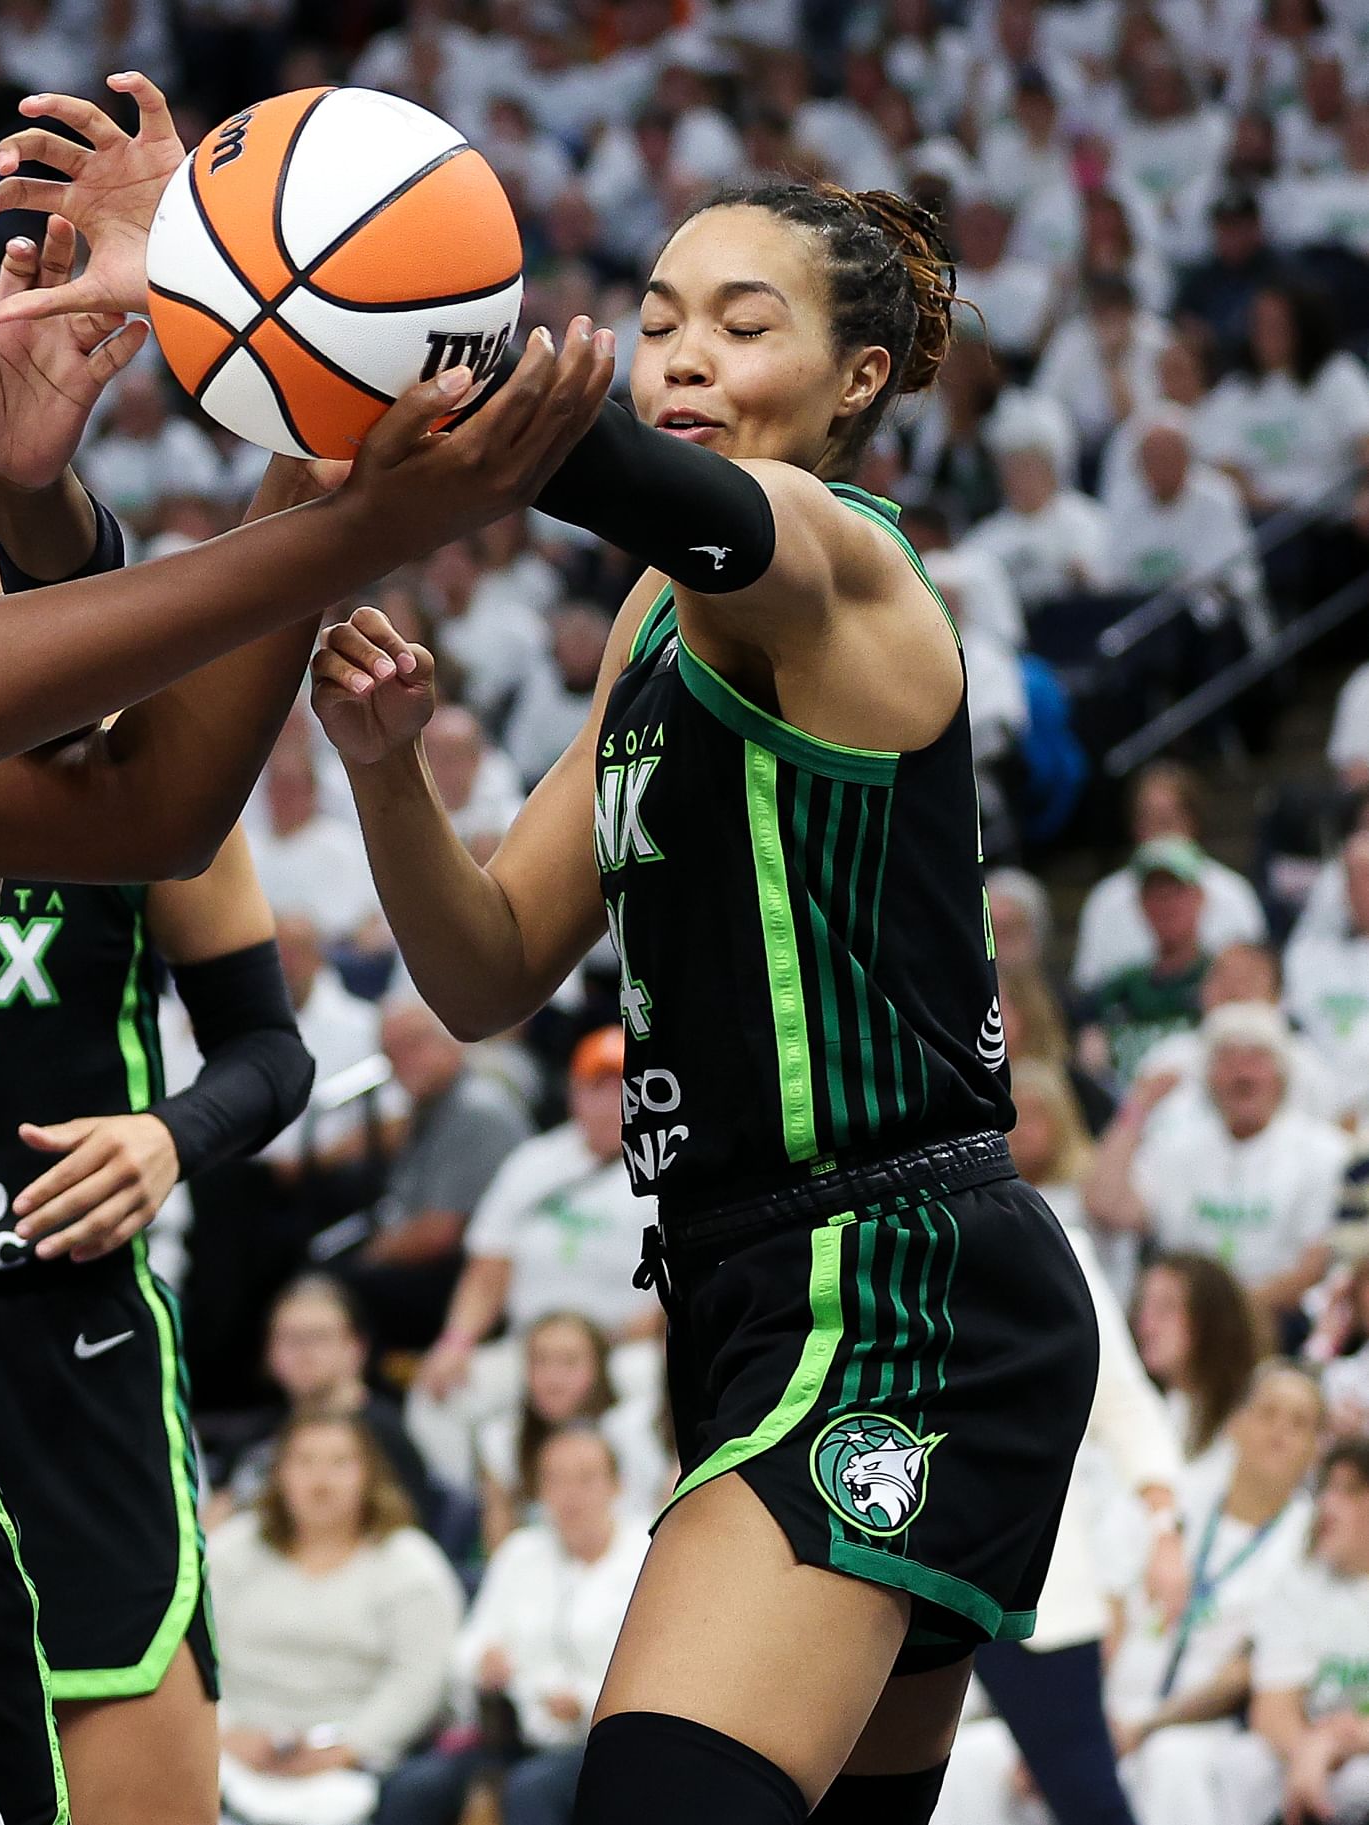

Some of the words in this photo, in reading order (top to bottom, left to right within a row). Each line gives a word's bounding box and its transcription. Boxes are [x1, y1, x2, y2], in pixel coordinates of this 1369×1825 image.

[602, 721, 665, 758] SOA
[13, 887, 65, 913] TA
[622, 1068, 681, 1125] AO
